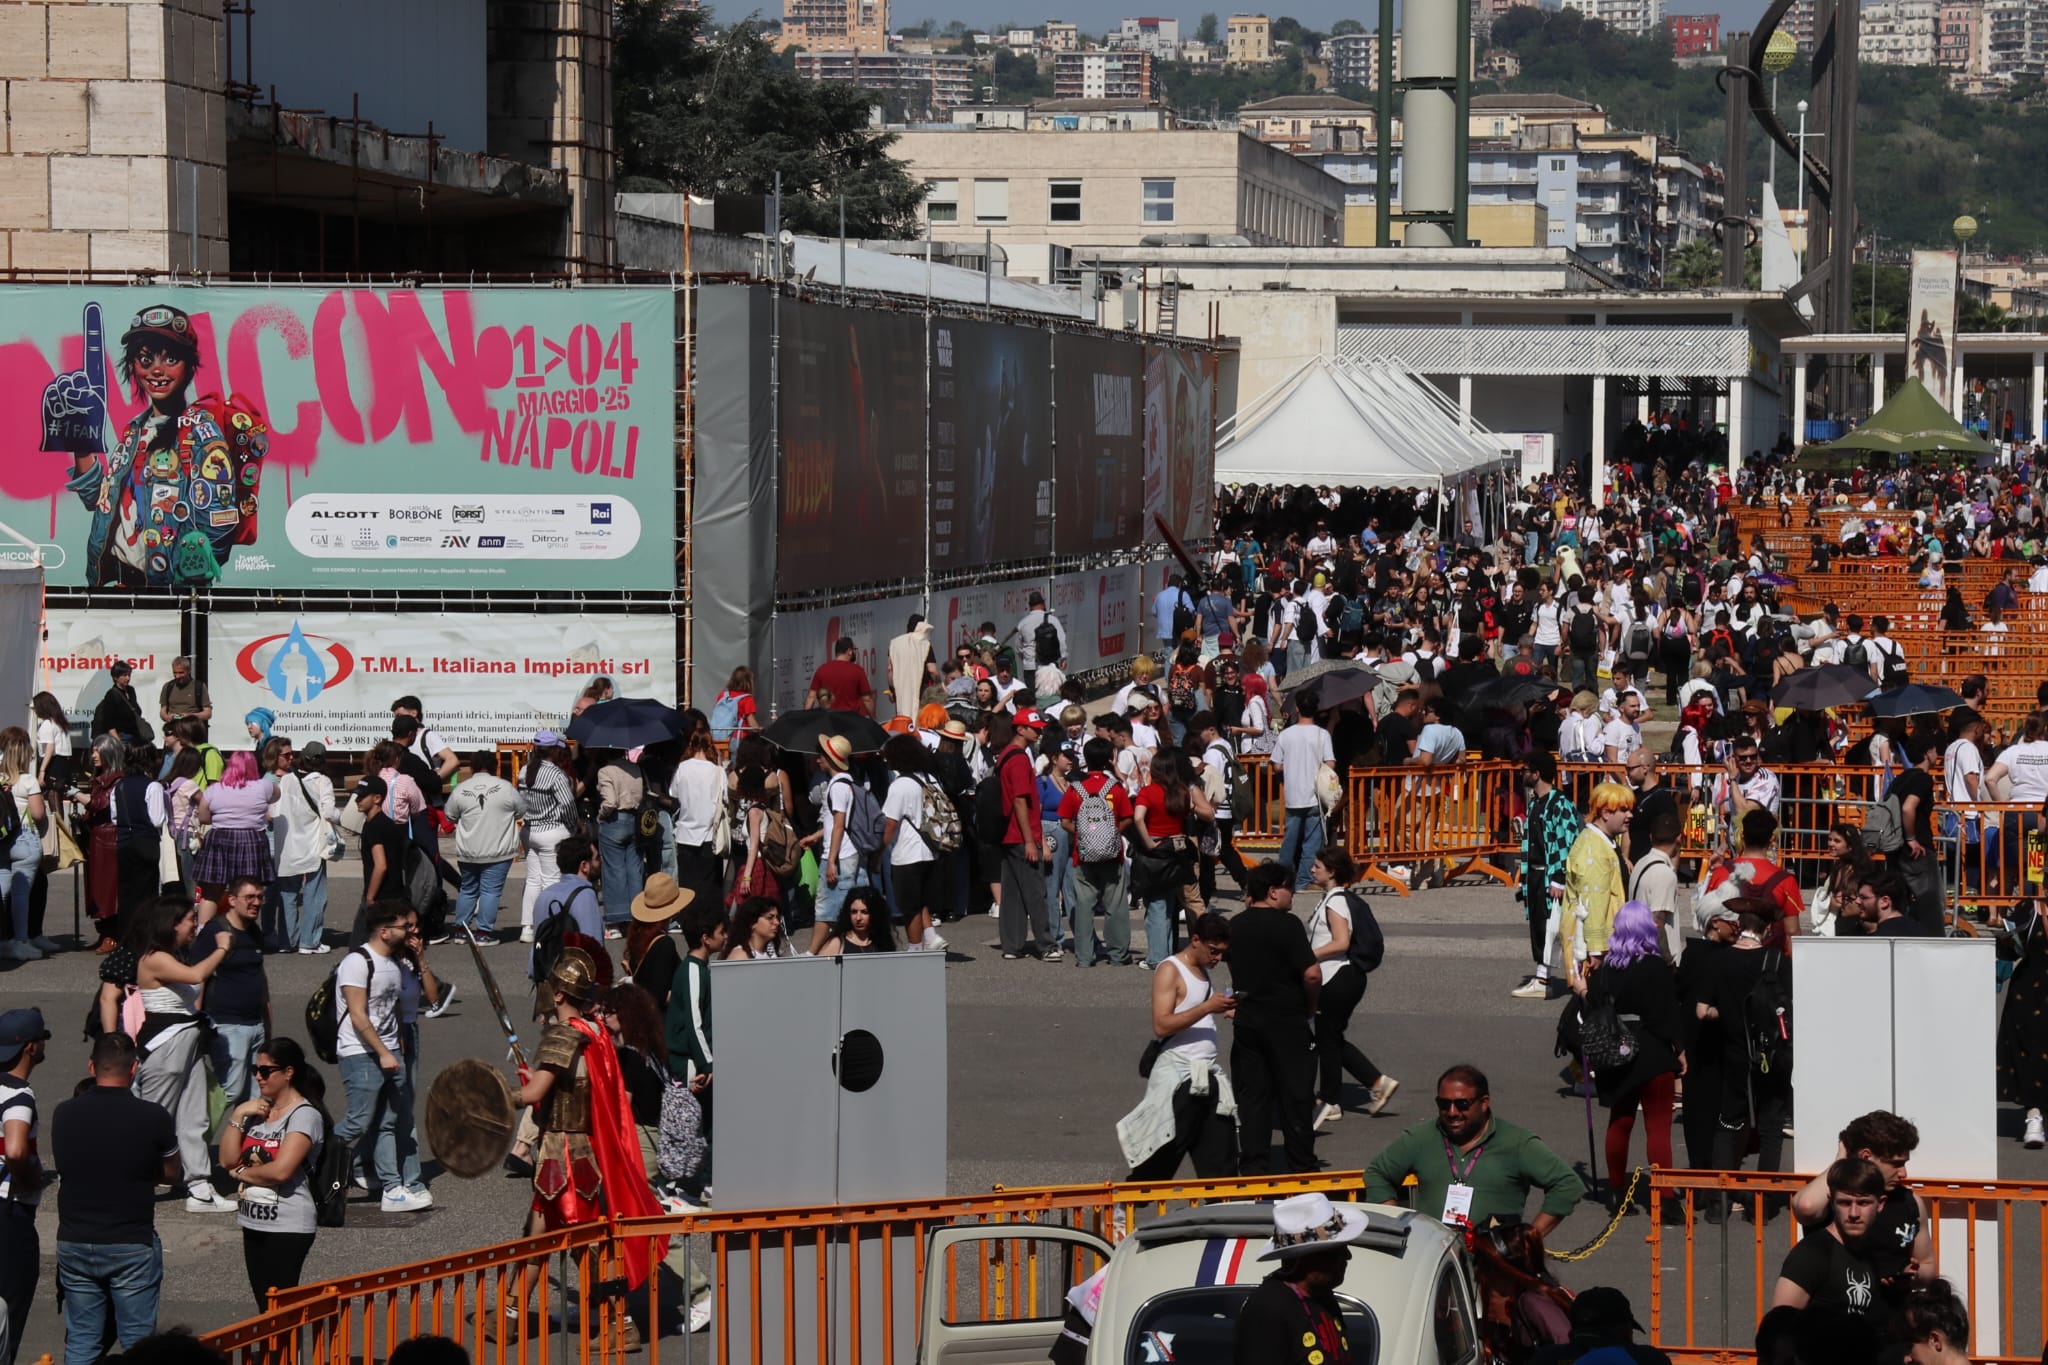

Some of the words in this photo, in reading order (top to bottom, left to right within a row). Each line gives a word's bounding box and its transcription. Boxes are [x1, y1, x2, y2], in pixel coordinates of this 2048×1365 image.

[178, 414, 201, 428] FONZ
[72, 424, 99, 440] FAN
[480, 407, 640, 479] NAPOLI
[311, 511, 380, 519] ALCOTT
[389, 508, 442, 520] BORBONE
[593, 508, 611, 519] Rai
[481, 537, 502, 547] anm
[40, 654, 119, 672] mpianti
[361, 657, 424, 673] T.M.L.
[433, 657, 516, 673] Italiana
[524, 658, 614, 677] Impianti
[622, 659, 649, 674] srl
[328, 709, 366, 721] impianti
[426, 711, 463, 721] impianti
[466, 710, 492, 721] idrici,
[494, 710, 532, 721] impianti
[534, 711, 569, 720] elettrici
[273, 723, 311, 733] impianti
[313, 723, 322, 732] di
[324, 723, 393, 733] condizionamen
[355, 736, 371, 746] 081
